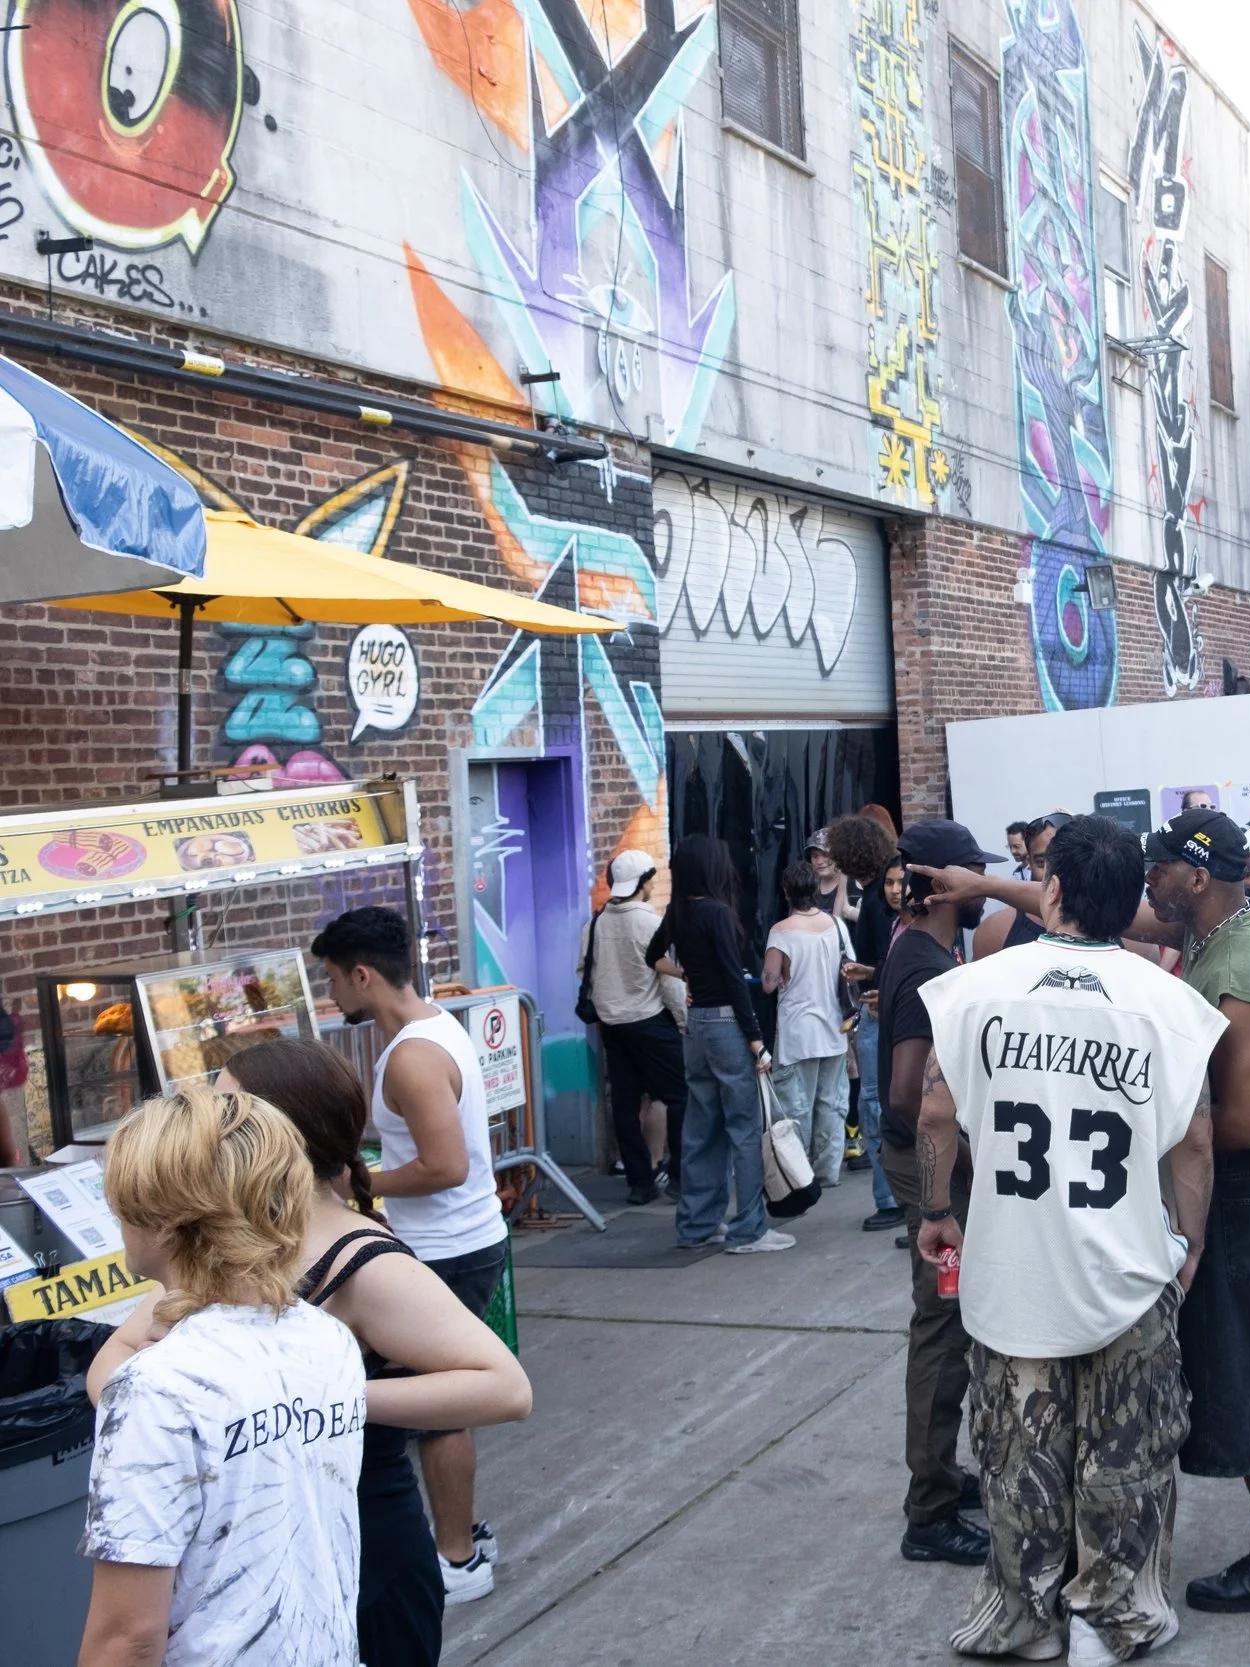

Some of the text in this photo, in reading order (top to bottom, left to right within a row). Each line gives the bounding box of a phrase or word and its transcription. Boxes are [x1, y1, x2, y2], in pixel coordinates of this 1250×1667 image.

[357, 639, 405, 667] HUGO
[357, 668, 406, 697] GYRL
[277, 798, 363, 822] CHURROS
[981, 1015, 1154, 1105] CHAVARRIA
[994, 1100, 1133, 1210] 33
